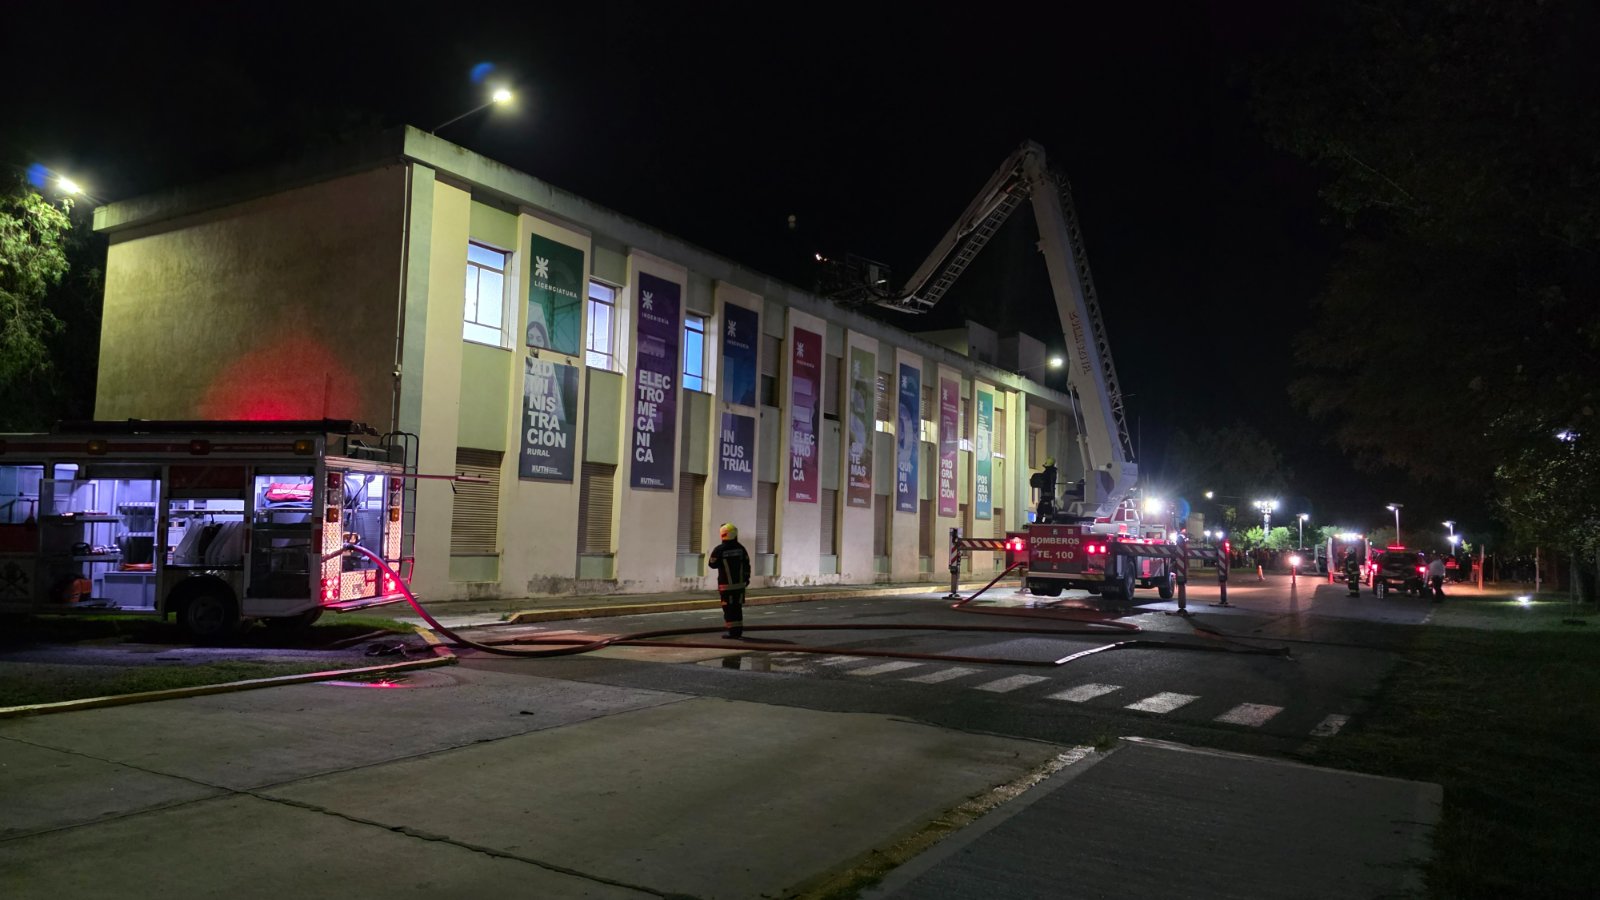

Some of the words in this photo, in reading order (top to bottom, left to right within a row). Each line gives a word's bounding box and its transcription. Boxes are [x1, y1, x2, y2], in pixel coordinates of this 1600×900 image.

[534, 281, 577, 298] LICENCIATURA
[530, 358, 553, 377] AD
[639, 369, 671, 390] ELEC
[638, 385, 664, 403] TRO
[529, 394, 556, 413] NIS
[638, 401, 657, 418] ME
[528, 411, 560, 430] TRA
[637, 432, 650, 447] NI
[723, 430, 734, 443] IN
[794, 431, 815, 446] ELEC
[527, 448, 550, 457] RURAL
[636, 448, 654, 463] CA
[723, 443, 744, 458] DUS
[722, 457, 751, 472] TRIAL
[793, 456, 802, 468] NI
[851, 454, 860, 464] TE
[941, 459, 953, 469] PRO
[792, 469, 805, 481] CA
[850, 464, 866, 477] MAS
[941, 468, 954, 479] GRA
[977, 475, 988, 485] POS
[899, 482, 908, 494] CA
[977, 484, 988, 494] GRA
[977, 493, 988, 503] DOS
[1030, 536, 1080, 545] BOMBEROS
[1037, 550, 1053, 559] TE.
[1056, 551, 1074, 559] 100
